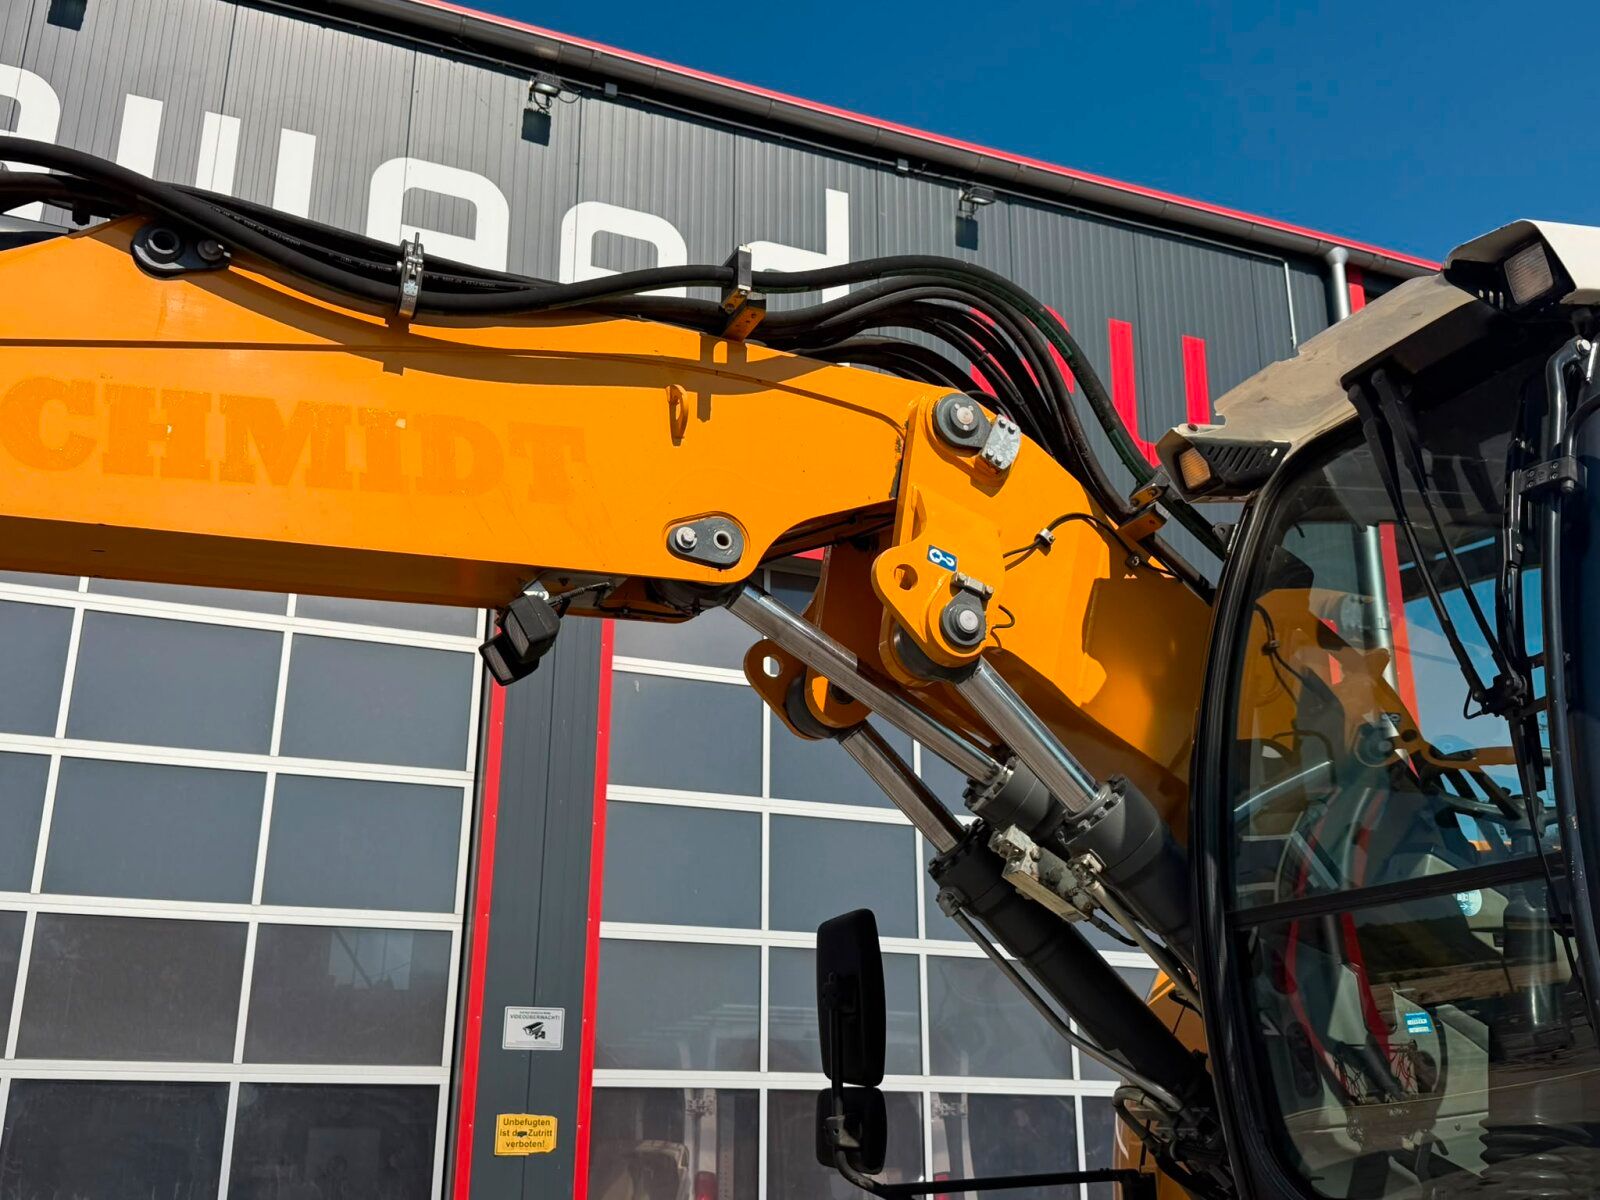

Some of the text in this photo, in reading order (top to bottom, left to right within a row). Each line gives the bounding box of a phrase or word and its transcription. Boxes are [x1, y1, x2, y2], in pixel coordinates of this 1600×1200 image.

[503, 1117, 551, 1128] Unbefugten
[499, 1127, 510, 1137] ist
[528, 1128, 553, 1137] Zutritt
[505, 1139, 545, 1148] verboten!
